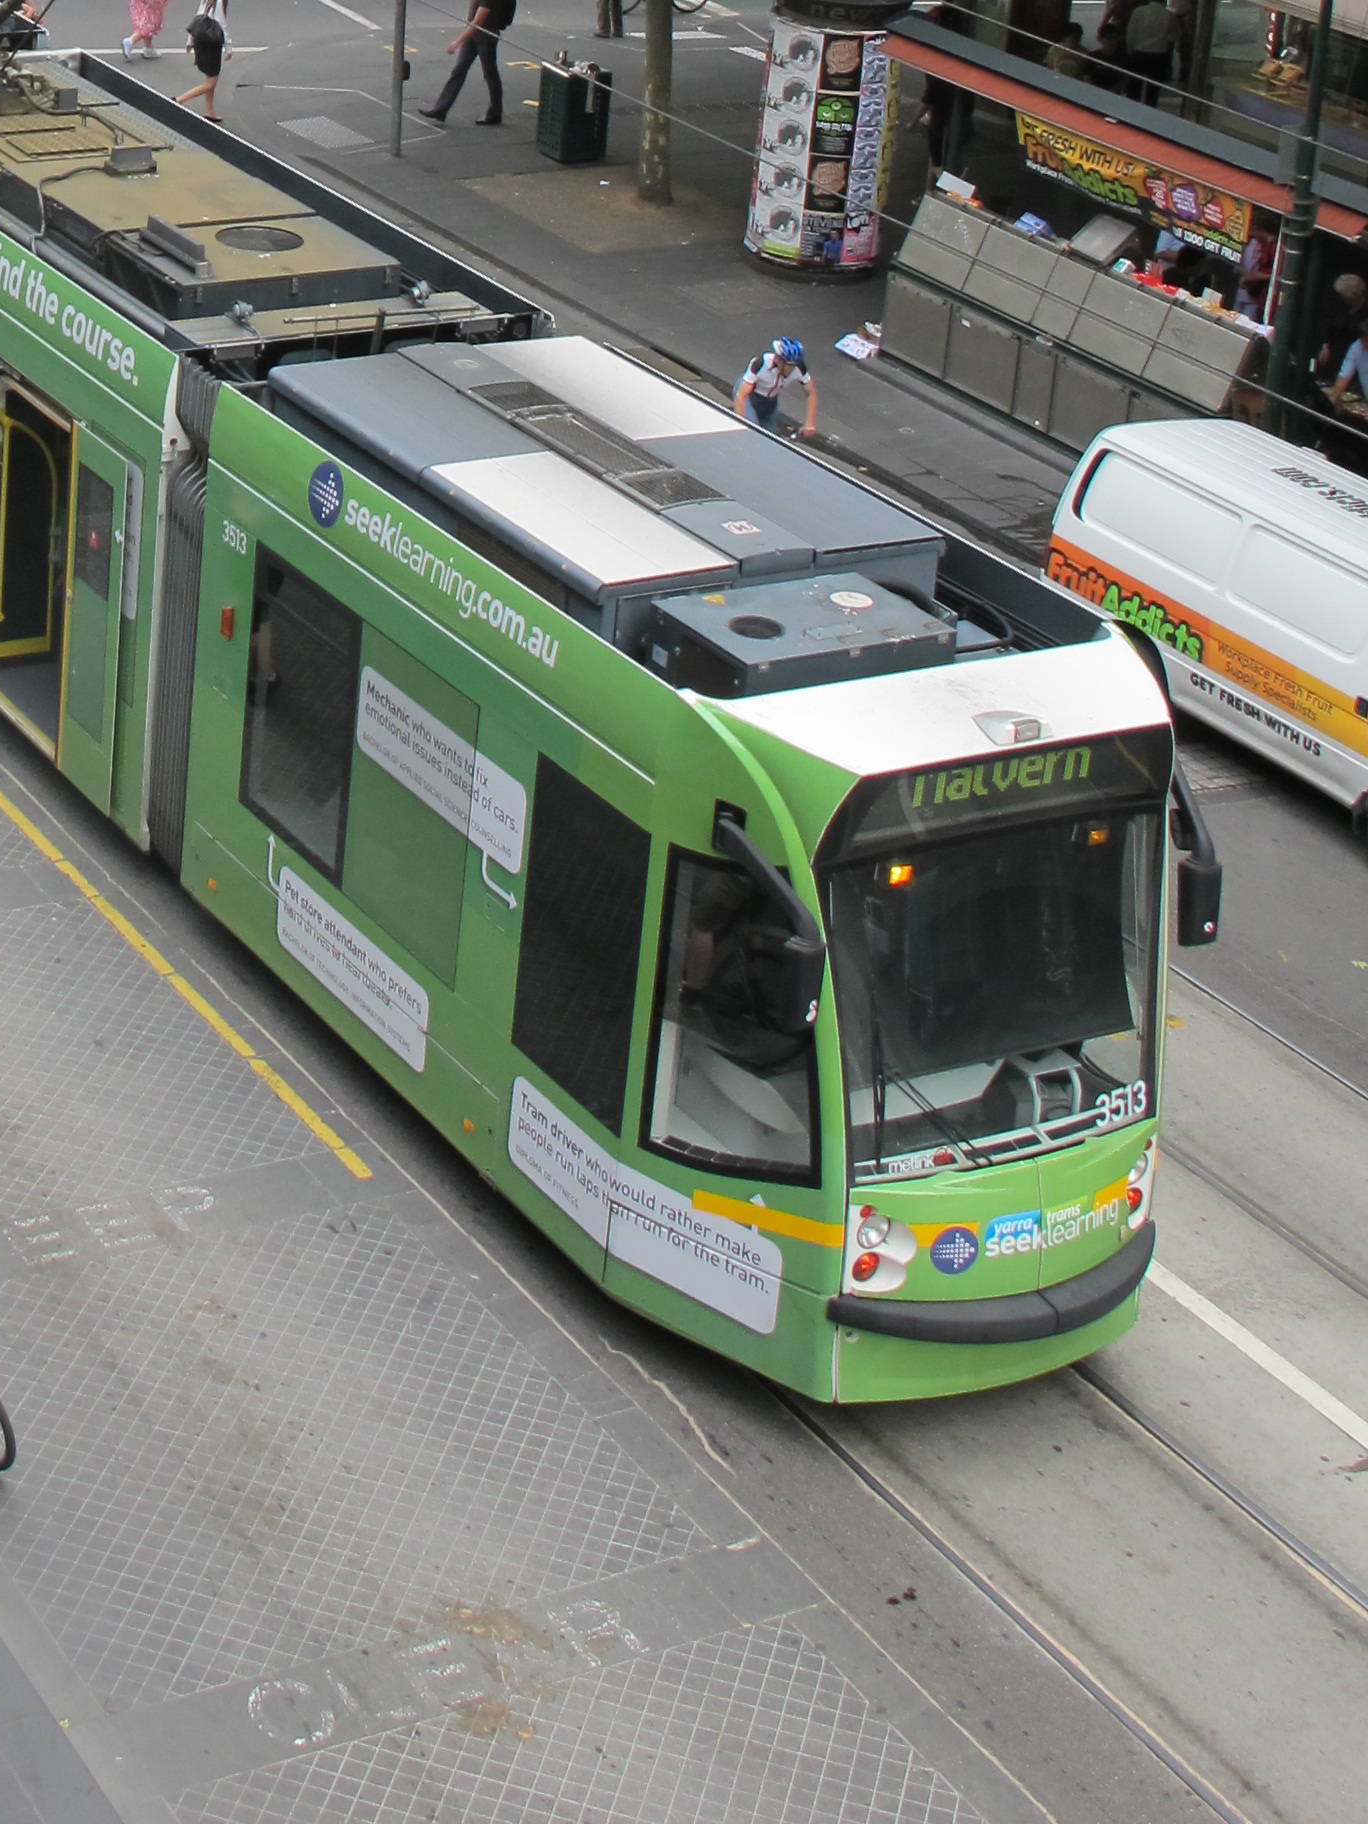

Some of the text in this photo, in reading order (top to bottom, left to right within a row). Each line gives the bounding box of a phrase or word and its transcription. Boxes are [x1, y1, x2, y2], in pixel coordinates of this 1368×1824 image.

[1079, 144, 1112, 170] WITH
[25, 269, 59, 325] the
[61, 304, 139, 387] course.
[221, 520, 247, 555] 3513
[344, 498, 559, 669] seeklearning.com.au
[1190, 672, 1322, 758] GET FRESH WITH US
[1216, 640, 1335, 716] Workplace Fresh Fruit
[1224, 660, 1318, 722] Supply Specialists
[364, 702, 519, 835] emotional issues instead of cars.
[366, 679, 489, 787] Mechanic who wants to fix
[284, 879, 423, 1015] Pet store attendant who prefers
[1095, 1079, 1147, 1127] 3513
[515, 1145, 543, 1173] DIPLOMA
[519, 1092, 762, 1267] Tram driver who would rather make
[888, 1155, 935, 1175] metlink
[517, 1116, 770, 1295] people run laps than run for the tram.
[984, 1197, 1120, 1258] seeklearning
[992, 1202, 1082, 1236] yarra trams
